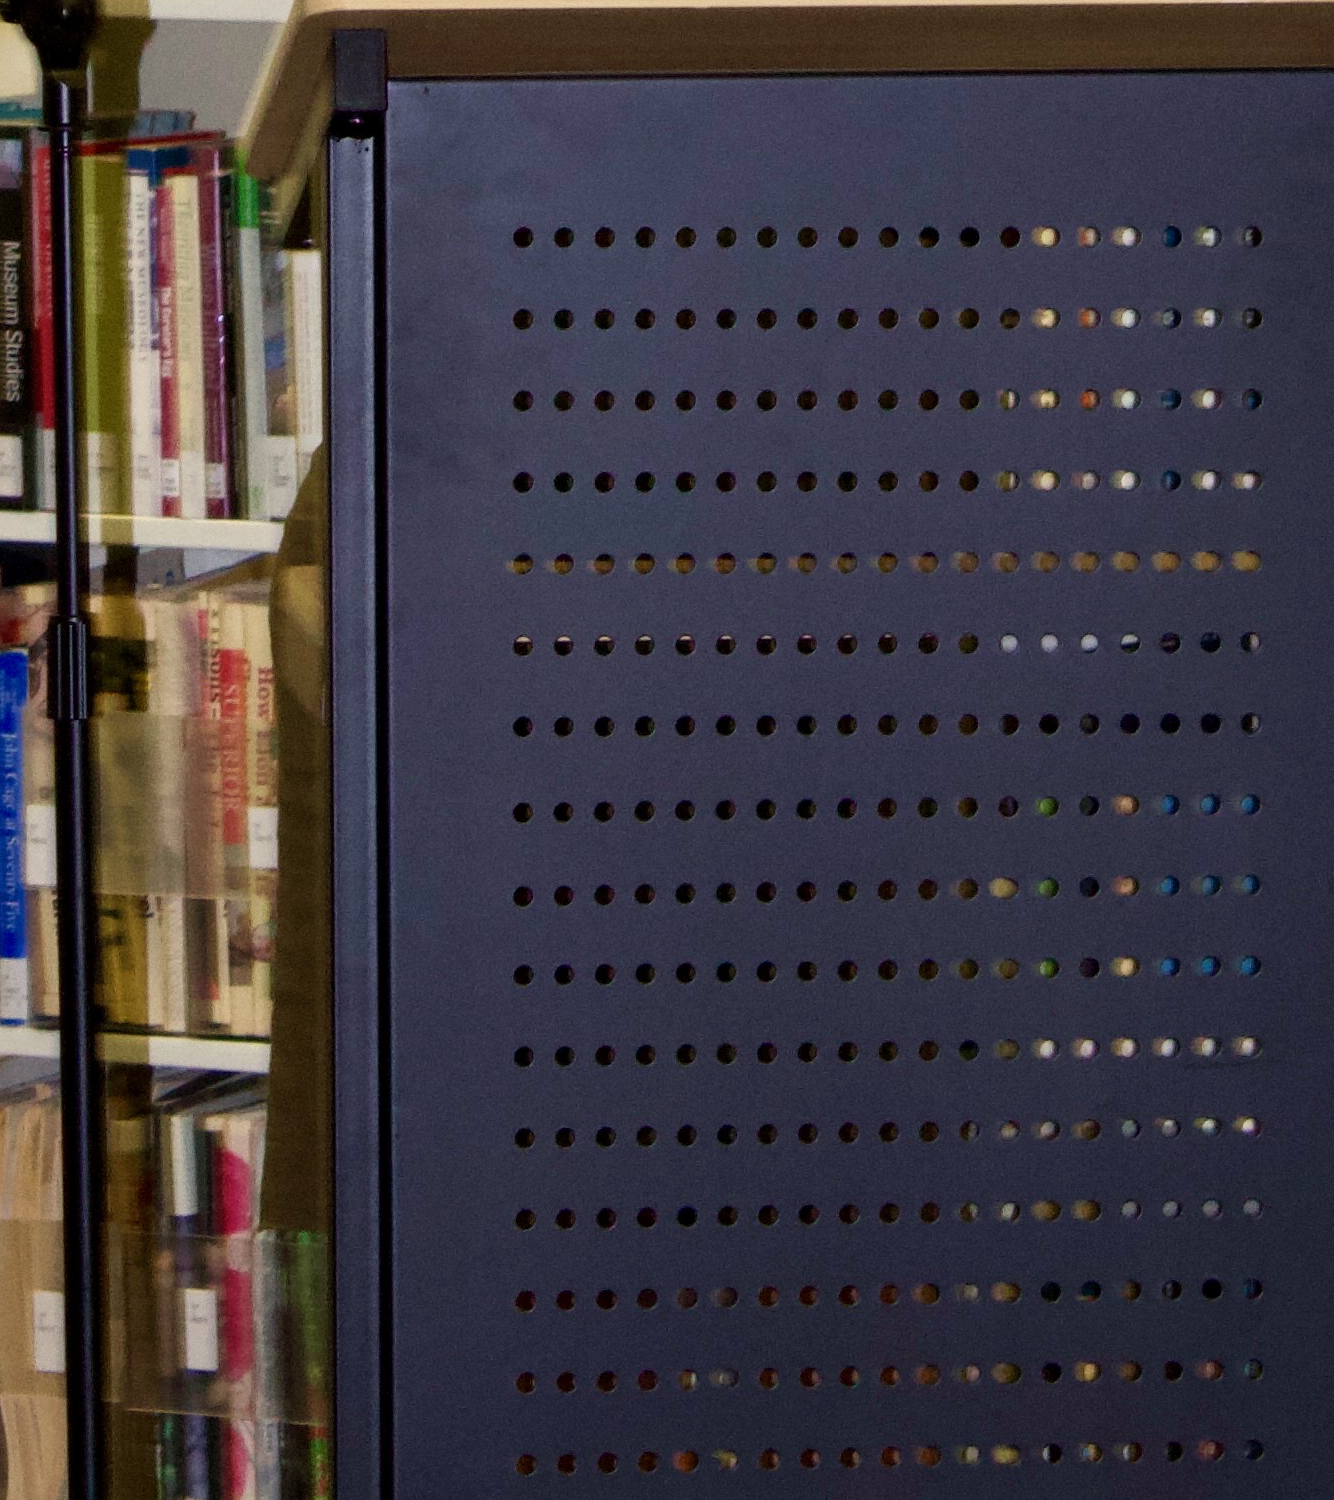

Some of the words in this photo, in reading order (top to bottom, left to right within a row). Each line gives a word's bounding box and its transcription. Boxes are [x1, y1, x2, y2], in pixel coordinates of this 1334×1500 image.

[3, 240, 21, 325] Museum
[4, 330, 23, 401] Studies
[257, 666, 275, 719] How
[5, 732, 23, 768] John
[0, 771, 20, 811] Cage
[3, 813, 19, 832] at
[1, 835, 20, 932] Seventy-Five
